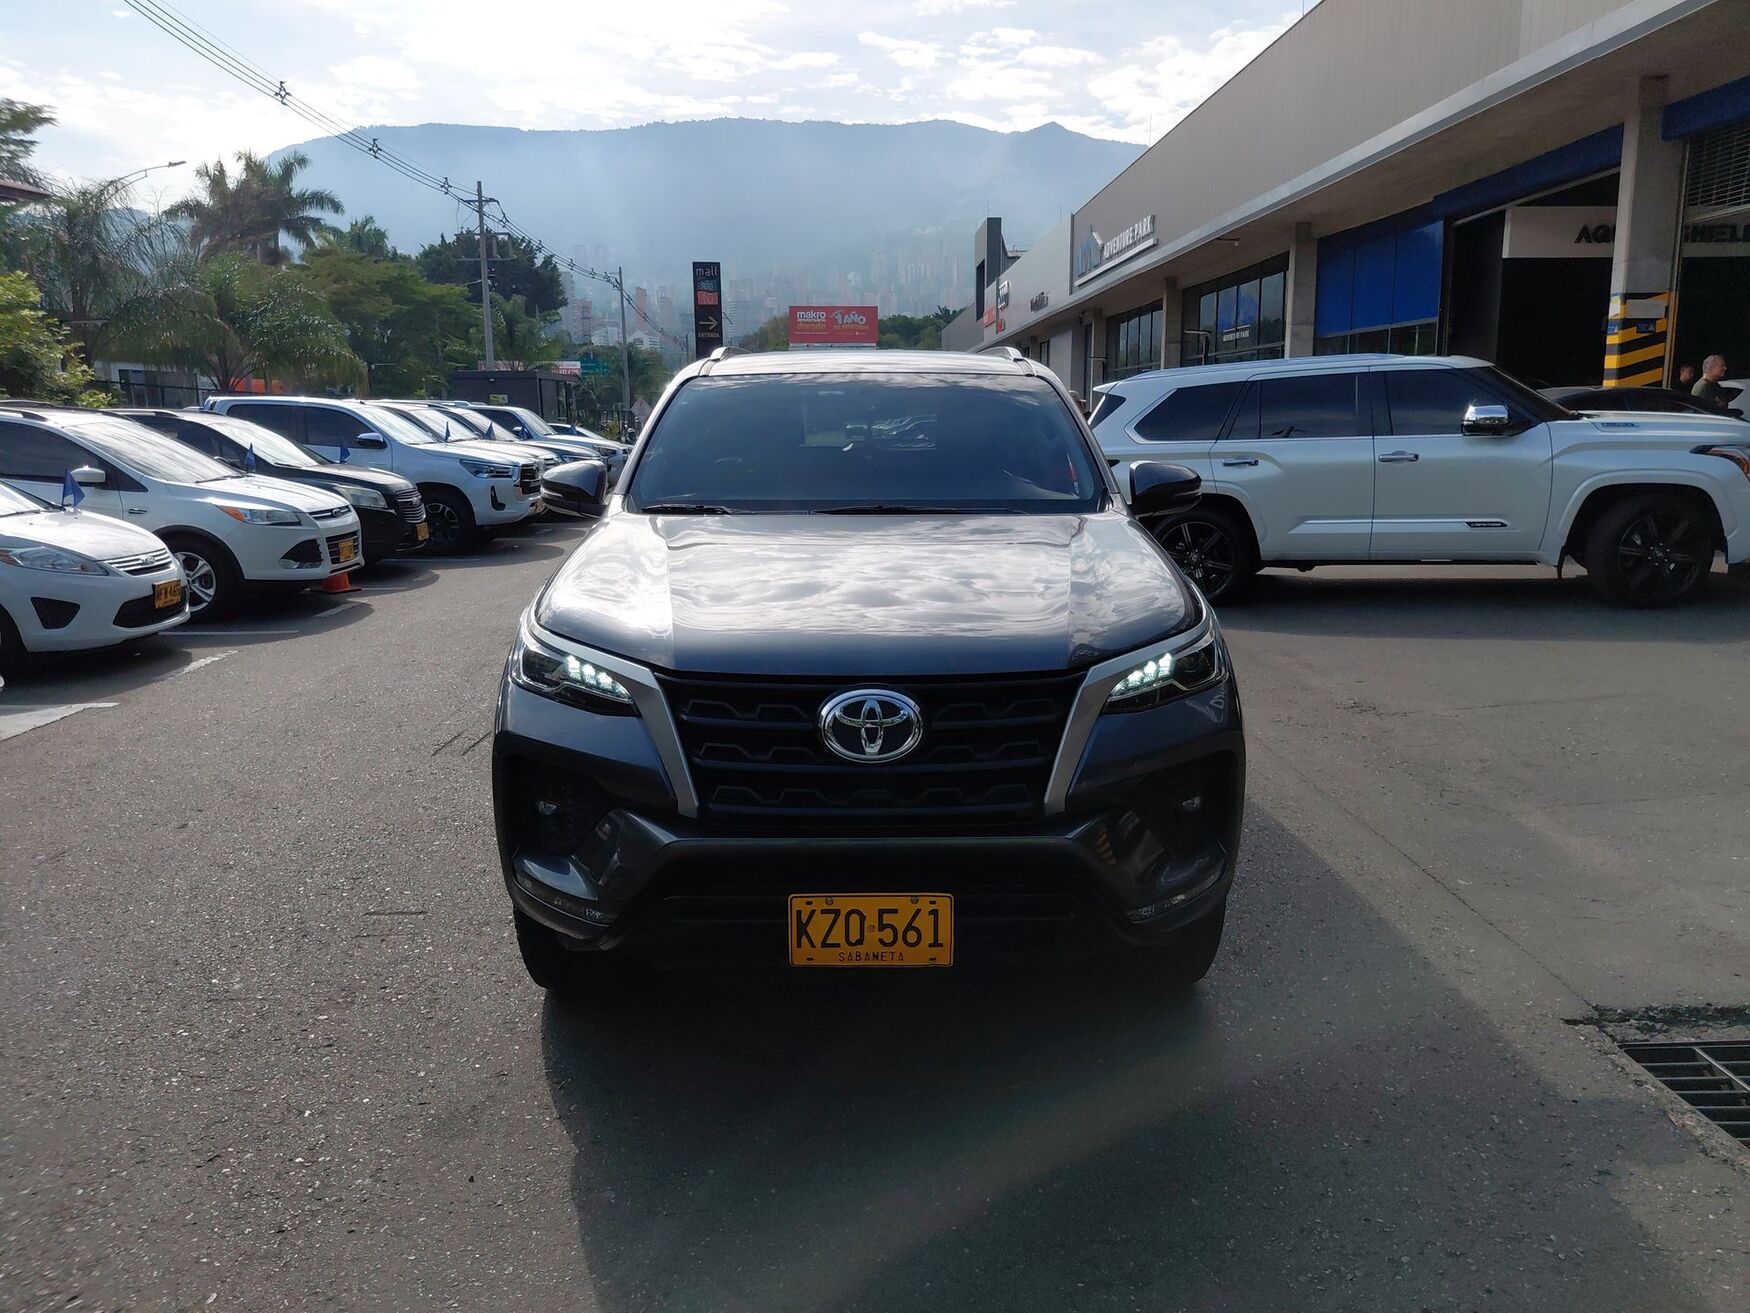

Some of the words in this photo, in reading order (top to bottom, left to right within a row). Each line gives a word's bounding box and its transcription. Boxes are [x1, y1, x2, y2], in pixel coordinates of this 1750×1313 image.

[1103, 226, 1134, 260] ADVENTURE
[1134, 214, 1155, 242] PARK
[1573, 223, 1616, 244] AQ
[695, 265, 718, 277] mall
[797, 310, 827, 320] makro
[844, 312, 866, 325] AÑO
[796, 908, 866, 949] KZQ
[878, 908, 944, 948] 561
[838, 951, 905, 962] SABANETA
